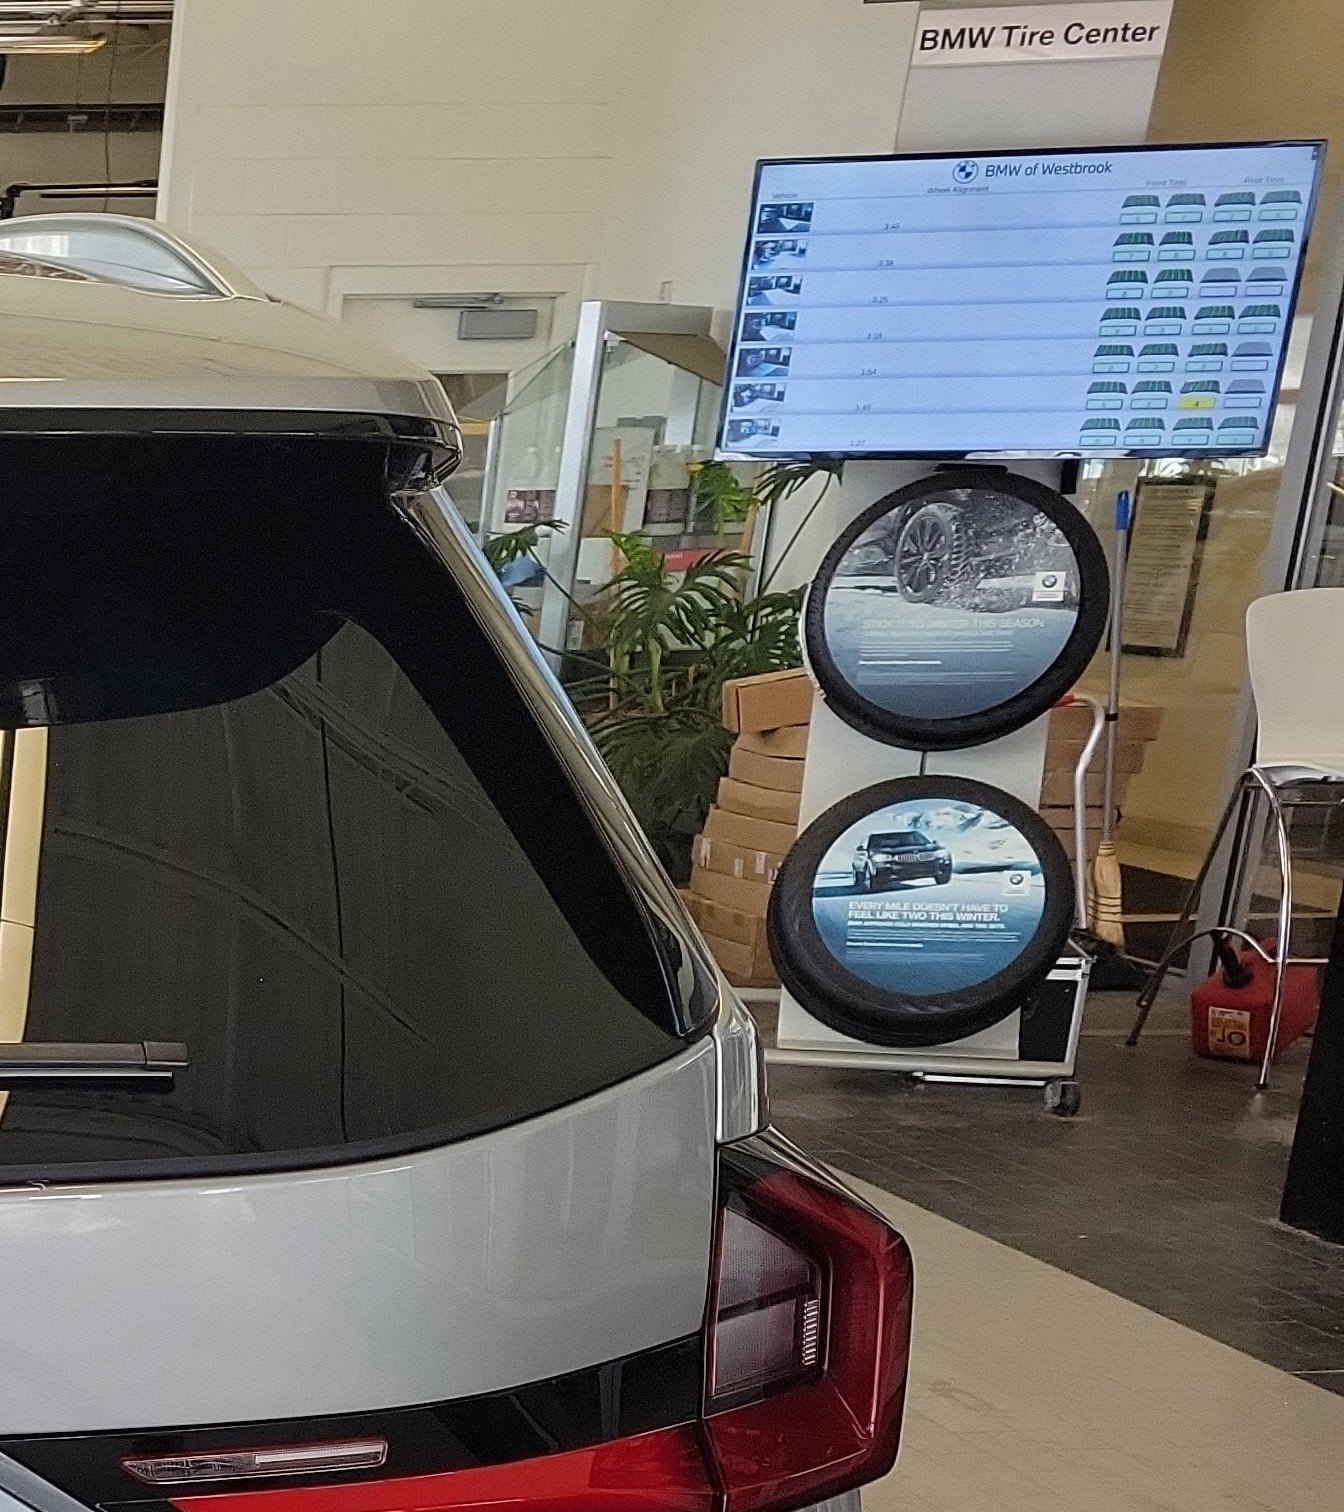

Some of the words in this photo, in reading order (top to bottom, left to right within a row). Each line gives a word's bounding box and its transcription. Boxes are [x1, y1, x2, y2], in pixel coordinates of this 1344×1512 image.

[920, 26, 996, 50] BMW
[1001, 25, 1055, 47] Tire
[1064, 22, 1161, 45] Center
[985, 164, 1022, 178] BMW
[1024, 163, 1039, 176] of
[1041, 161, 1113, 176] Westbrook
[849, 902, 884, 911] EVERY
[885, 902, 912, 911] MILE
[913, 903, 959, 912] DOESN'T
[962, 903, 991, 912] HAVE
[993, 904, 1009, 913] TO
[848, 910, 874, 919] FEEL
[876, 911, 900, 920] LIKE
[902, 911, 928, 920] TWO
[930, 912, 954, 921] THIS
[955, 912, 1001, 922] WINTER.
